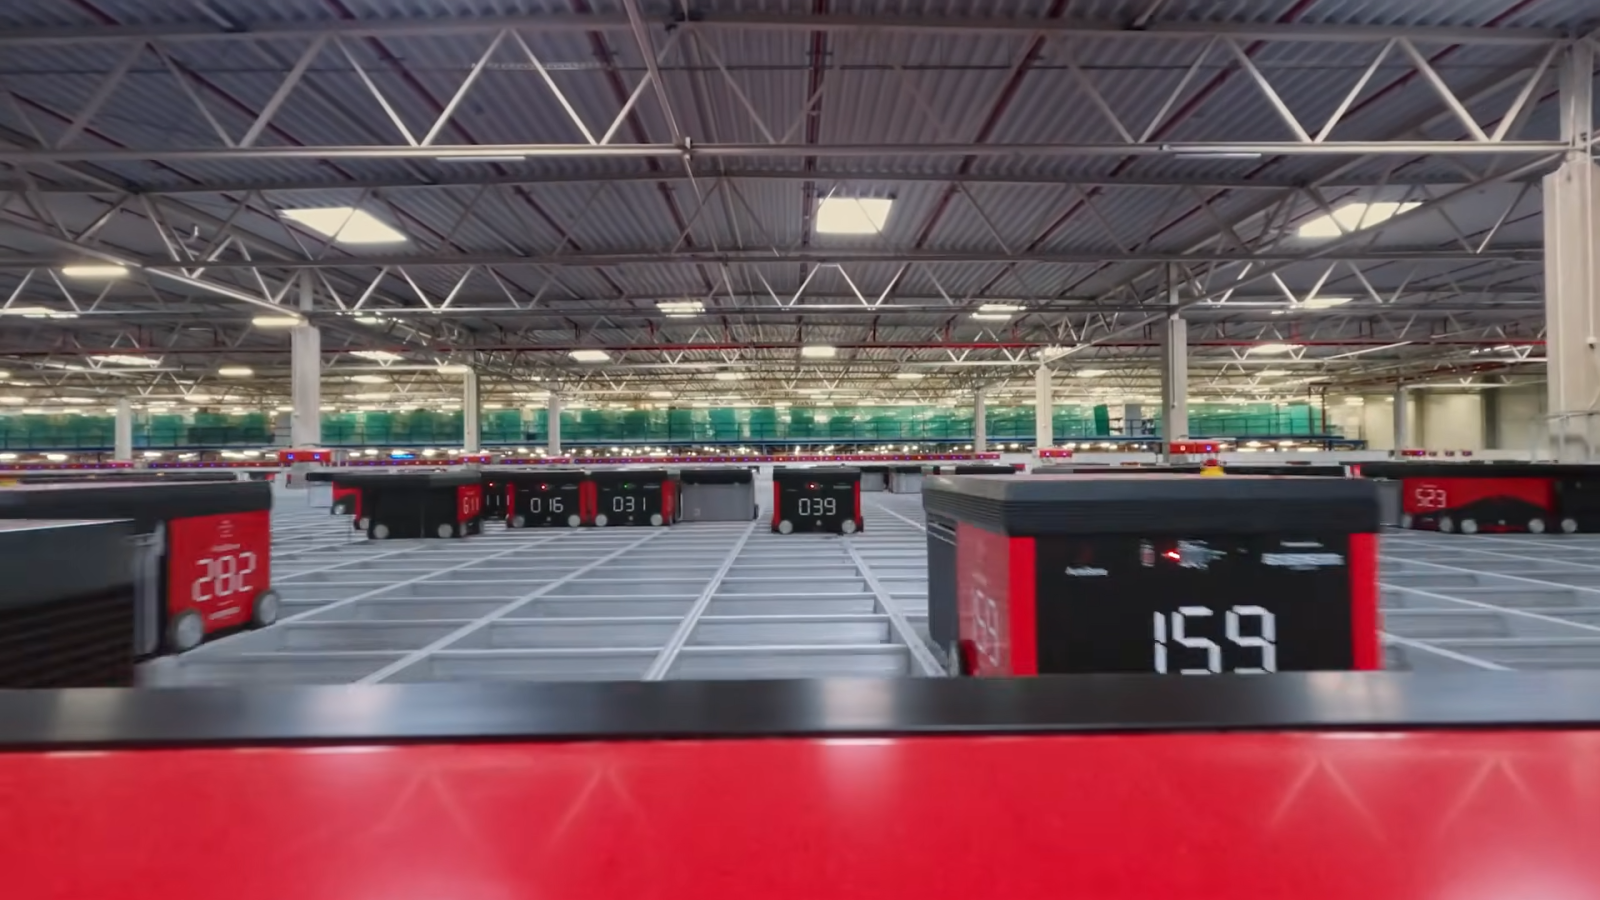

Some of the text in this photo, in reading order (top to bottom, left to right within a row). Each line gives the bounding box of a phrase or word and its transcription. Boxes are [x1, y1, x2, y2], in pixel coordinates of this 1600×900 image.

[530, 497, 564, 513] 016
[612, 496, 646, 513] 031
[798, 497, 836, 516] 039
[1415, 488, 1447, 508] 523
[191, 551, 257, 602] 282
[1153, 604, 1277, 675] 159
